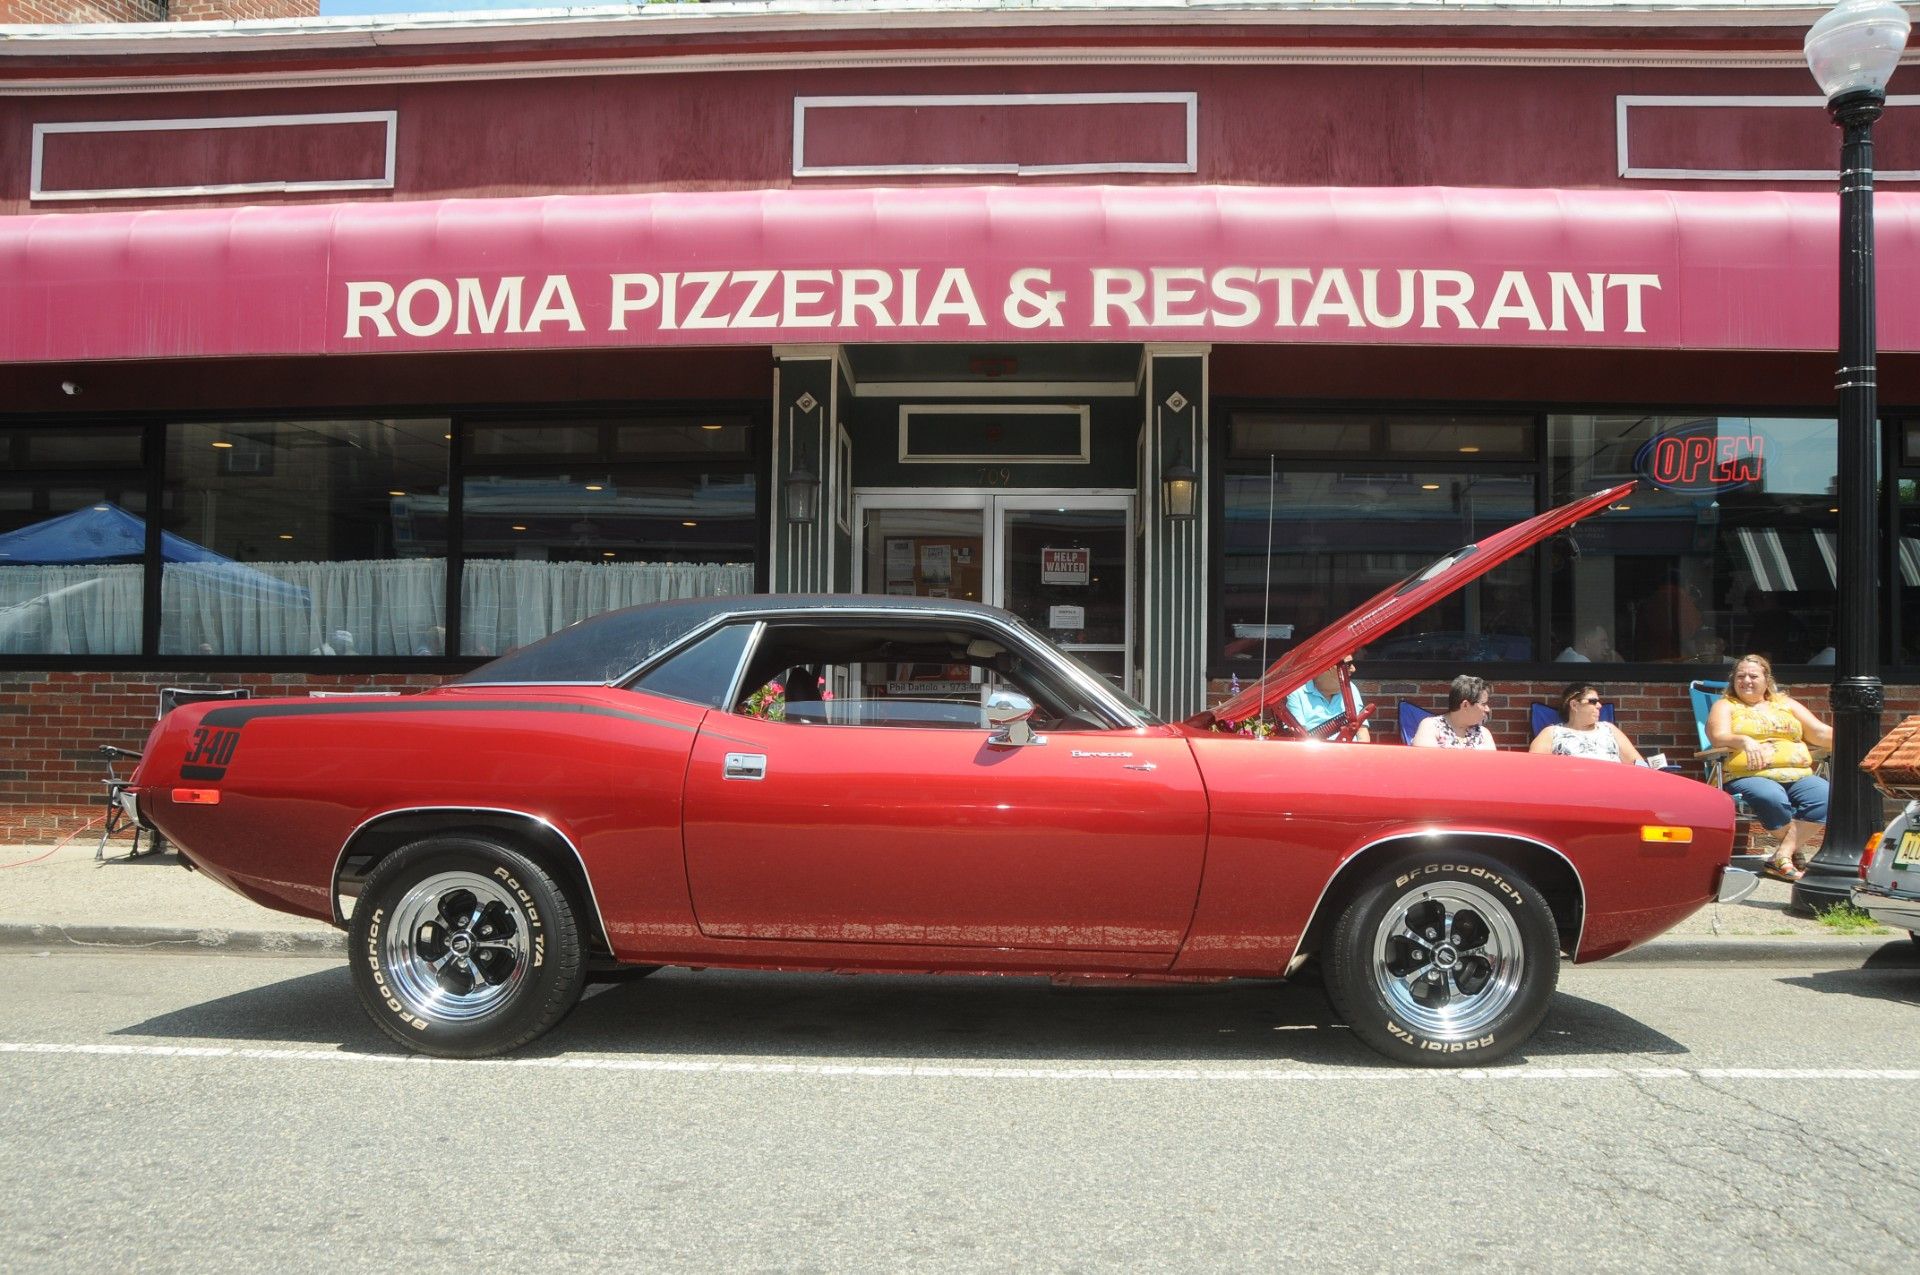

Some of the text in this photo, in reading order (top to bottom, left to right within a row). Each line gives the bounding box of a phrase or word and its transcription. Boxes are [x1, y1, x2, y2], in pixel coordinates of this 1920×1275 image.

[343, 267, 1662, 338] ROMA PIZZERIA & RESTAURANT
[976, 464, 1010, 488] 709
[1654, 436, 1764, 483] OPEN
[1046, 562, 1085, 572] WANTED
[1053, 551, 1078, 562] HELP
[889, 682, 906, 691] Phil
[184, 728, 240, 766] 340
[1395, 864, 1523, 905] BFGoodrich
[494, 866, 545, 968] Radial T/A
[367, 908, 430, 1031] BFGoodrich
[1386, 1021, 1495, 1054] Radial T/A
